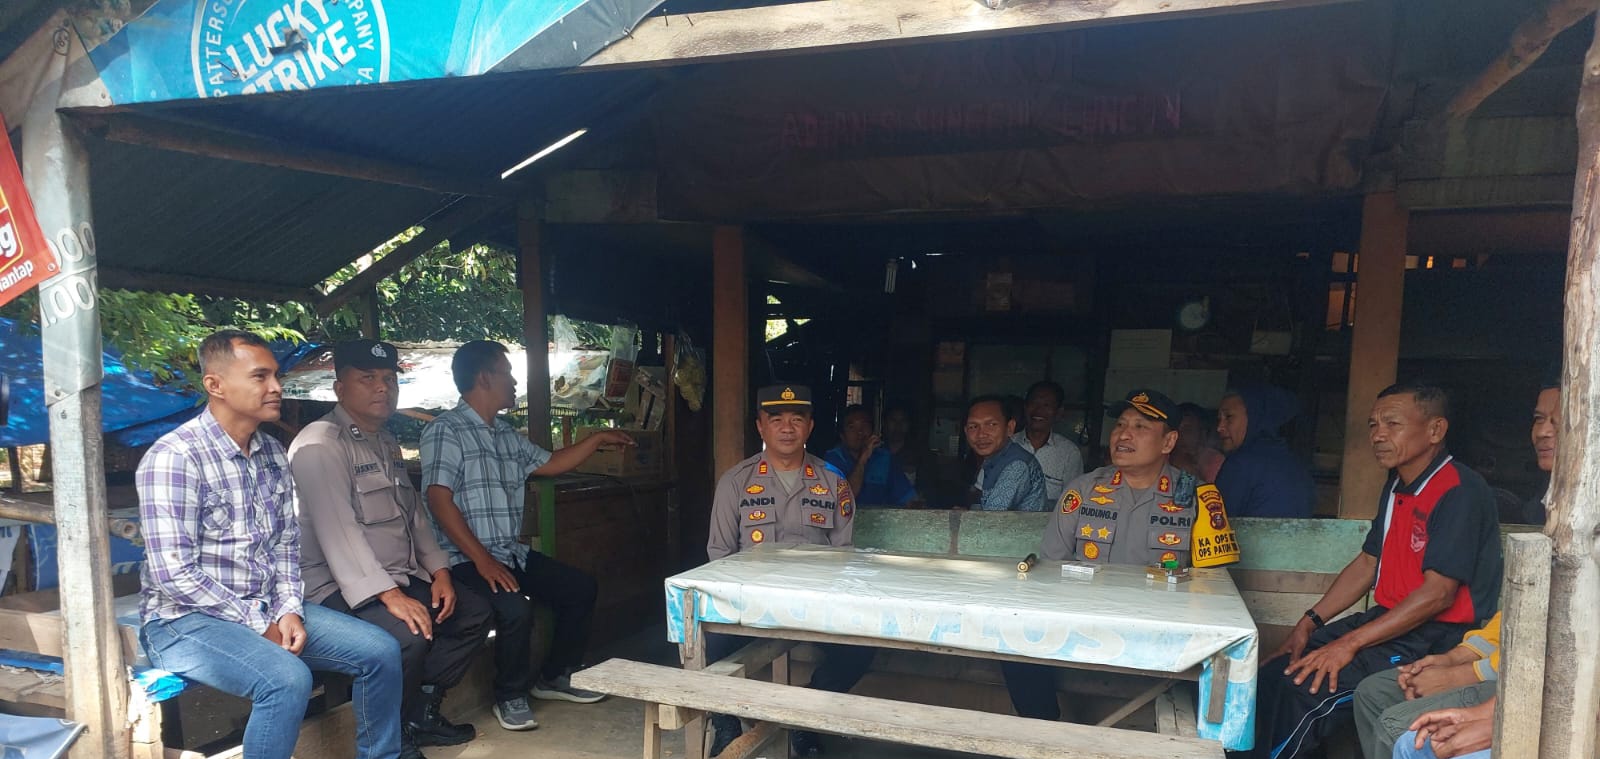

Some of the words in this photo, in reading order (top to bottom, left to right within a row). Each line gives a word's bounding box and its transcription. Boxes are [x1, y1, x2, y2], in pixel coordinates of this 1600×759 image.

[344, 0, 375, 50] PANY
[740, 497, 775, 507] ANDI
[801, 497, 836, 509] POLRI
[1150, 515, 1191, 527] POLRI
[1198, 537, 1211, 547] KA
[1214, 533, 1229, 544] OPS
[1198, 547, 1211, 557] OPS
